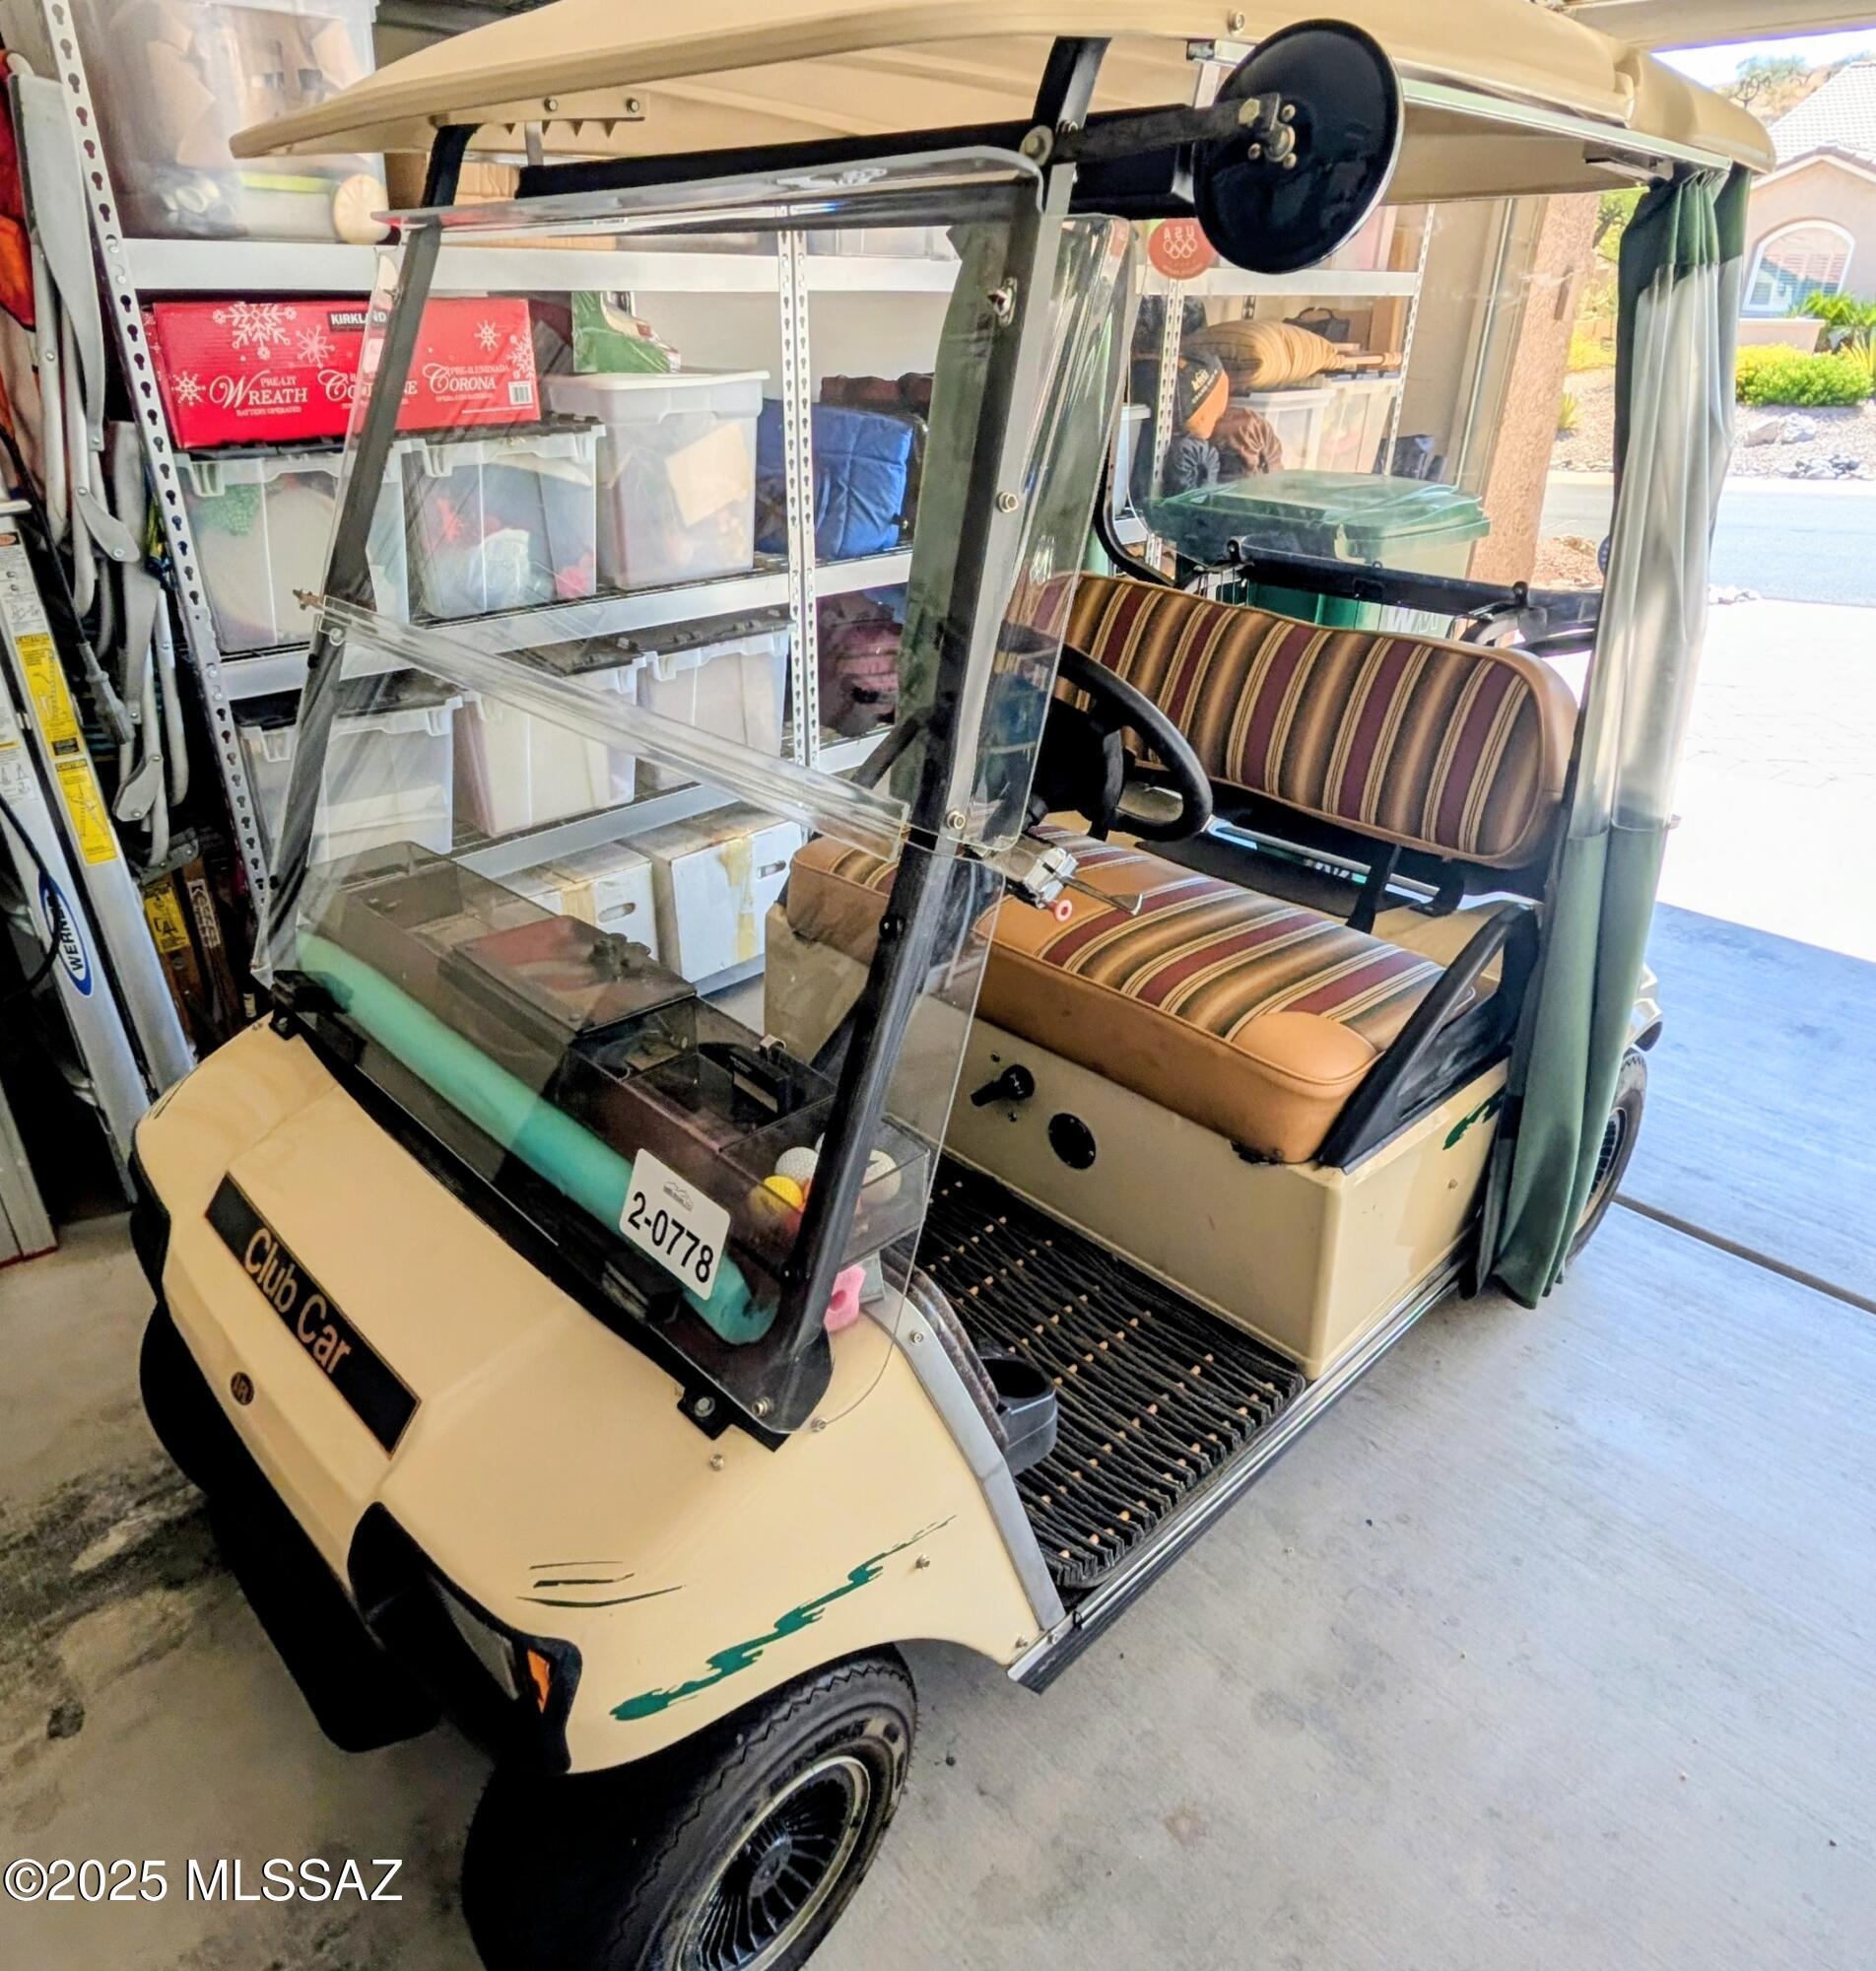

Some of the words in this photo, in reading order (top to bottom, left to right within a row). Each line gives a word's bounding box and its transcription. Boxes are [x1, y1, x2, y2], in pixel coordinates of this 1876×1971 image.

[330, 311, 387, 325] KIRKLND
[628, 1191, 713, 1282] 2-0778
[244, 1228, 298, 1313] Club
[298, 1294, 351, 1374] Car
